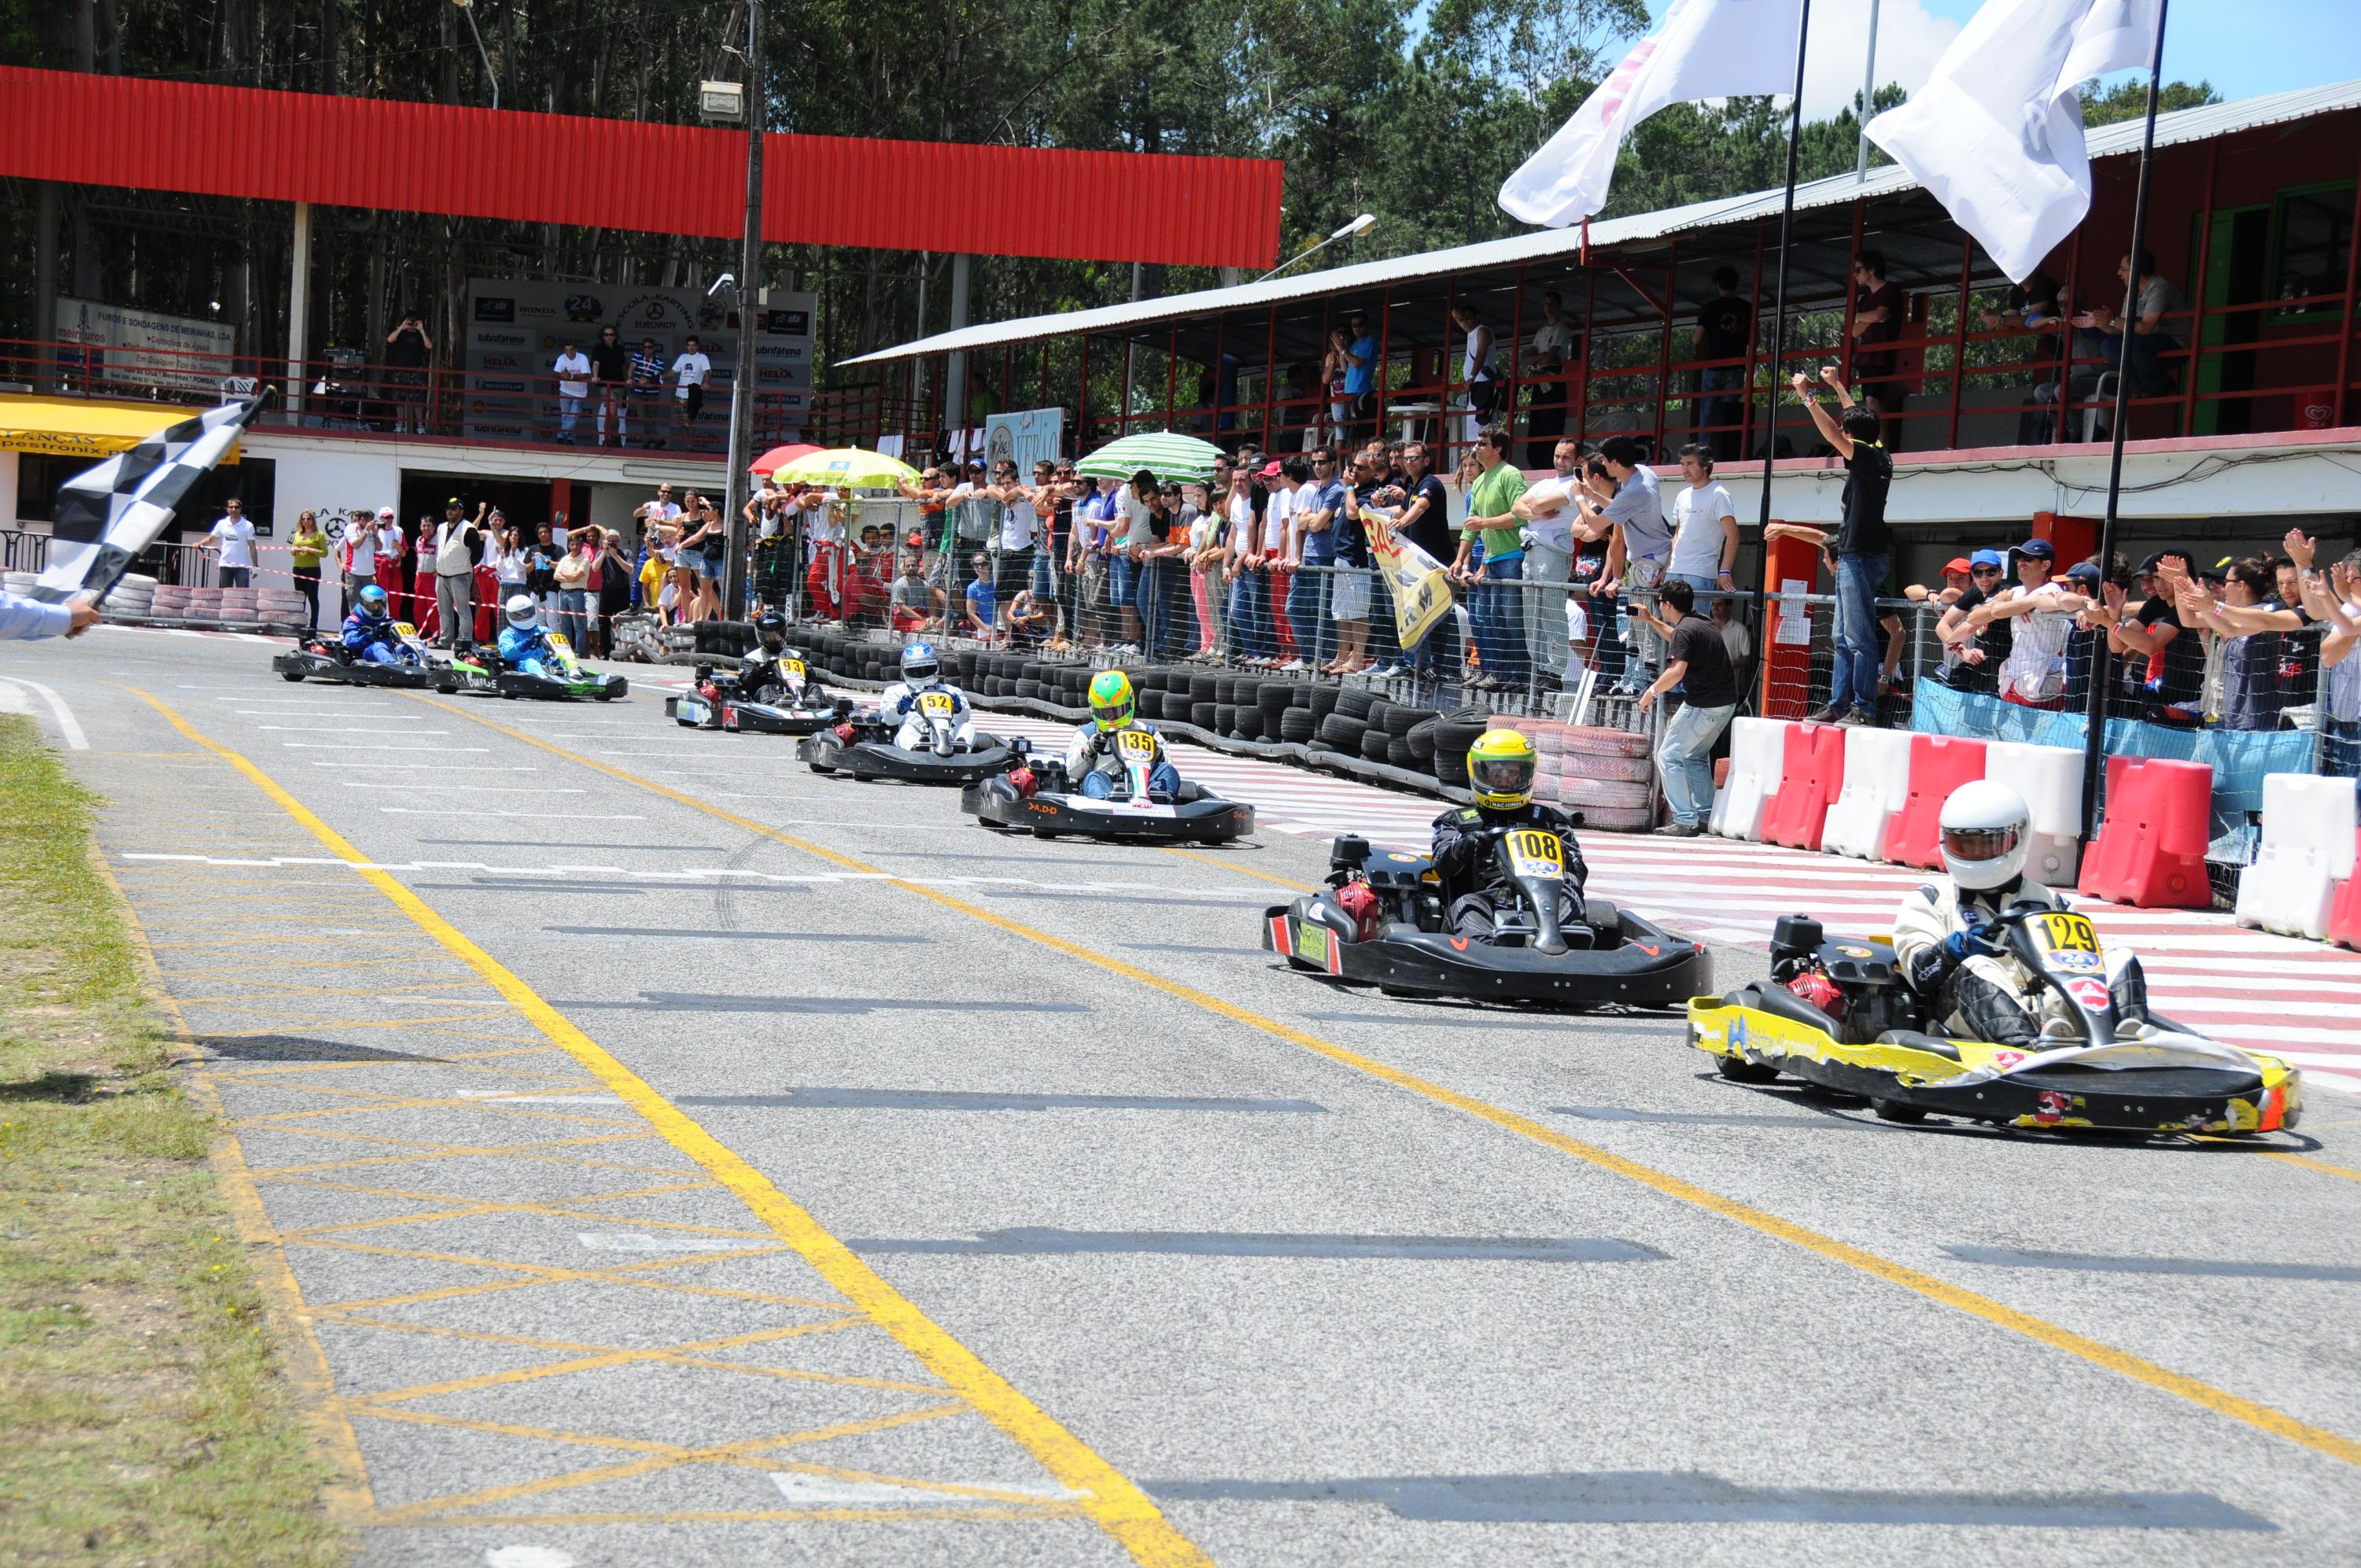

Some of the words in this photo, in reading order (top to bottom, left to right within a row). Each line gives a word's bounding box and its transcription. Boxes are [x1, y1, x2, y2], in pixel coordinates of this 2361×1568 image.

[616, 294, 649, 327] ESCOLA
[98, 312, 120, 323] FUROS
[129, 319, 170, 332] SONDAGENS
[171, 325, 180, 334] DE
[484, 356, 517, 367] HELIX
[194, 376, 216, 386] POMBAL
[759, 370, 793, 378] HELIX
[784, 661, 801, 672] 93
[927, 695, 948, 708] 52
[1120, 734, 1151, 751] 135
[1511, 834, 1558, 861] 108
[2037, 916, 2097, 953] 129
